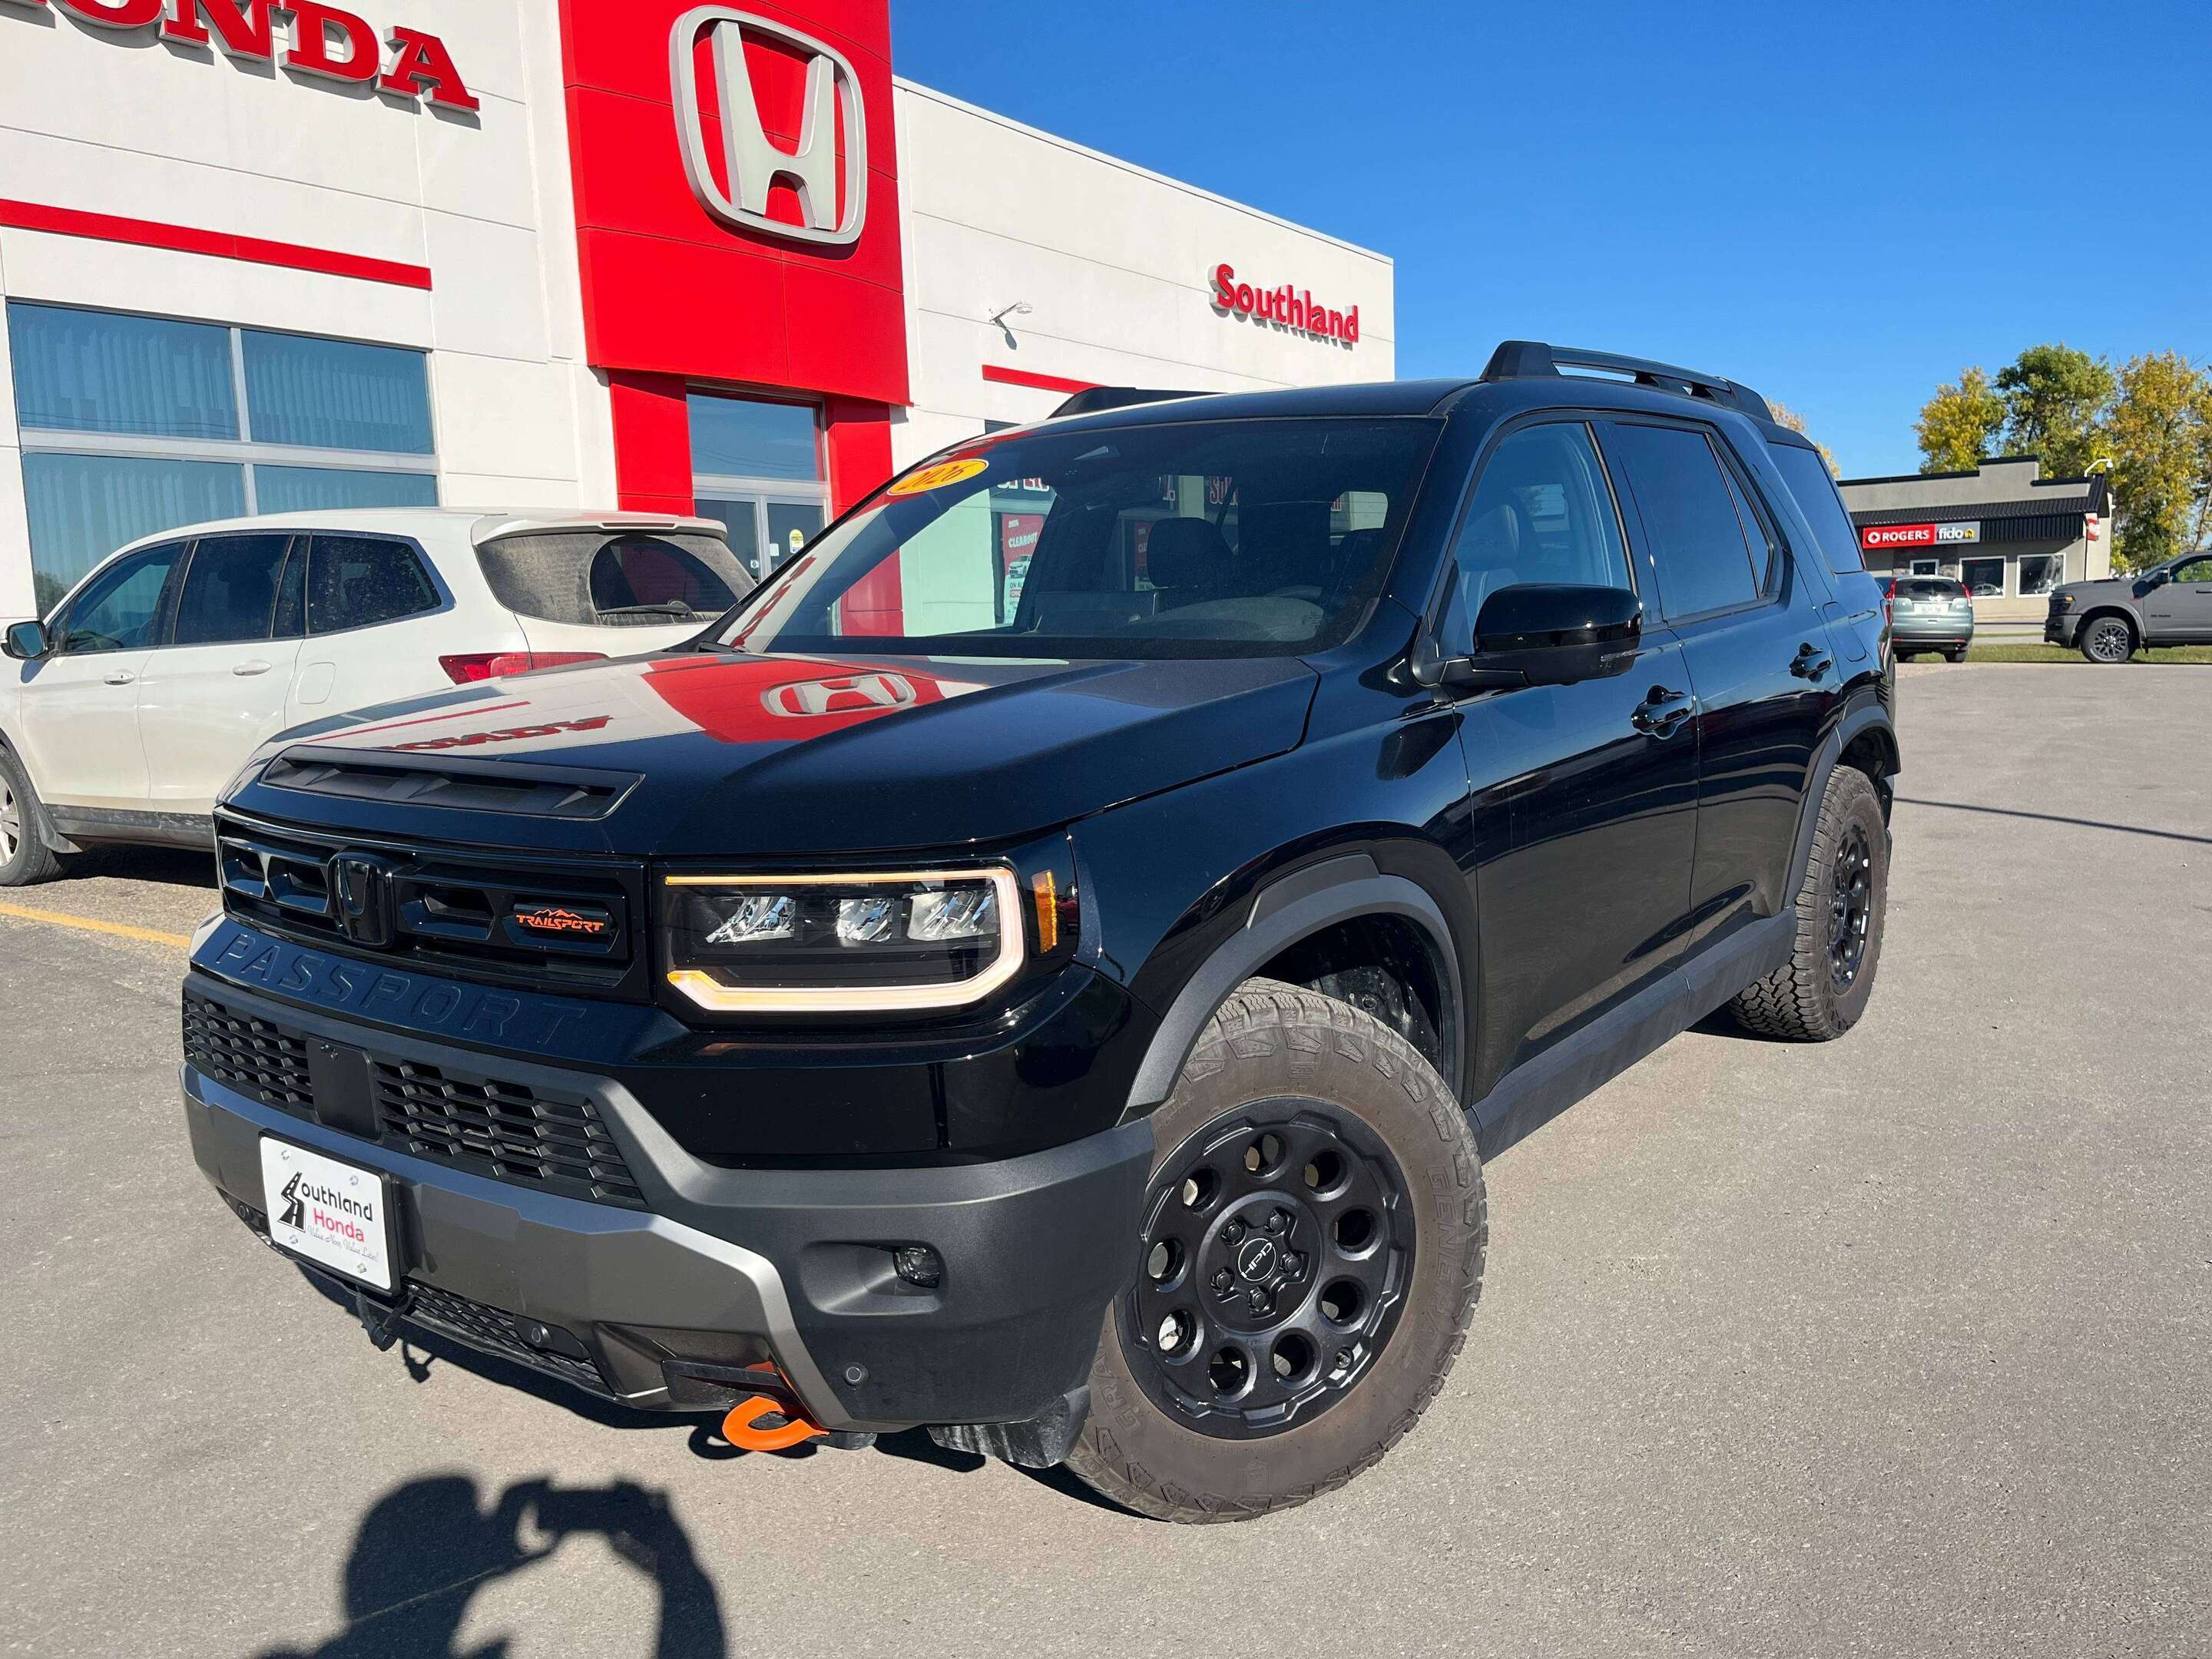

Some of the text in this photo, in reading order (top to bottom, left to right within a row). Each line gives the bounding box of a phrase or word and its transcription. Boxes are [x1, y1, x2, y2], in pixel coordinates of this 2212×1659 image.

[0, 0, 480, 113] NDA
[1210, 263, 1359, 343] Southland
[1882, 529, 1930, 542] ROGERS
[1938, 527, 1964, 541] fido
[515, 914, 604, 933] TRAILSPORT
[216, 933, 588, 1045] PASSPORT
[313, 1207, 365, 1243] Honda
[1240, 1242, 1273, 1278] HPD
[1414, 1166, 1457, 1366] GENERAL
